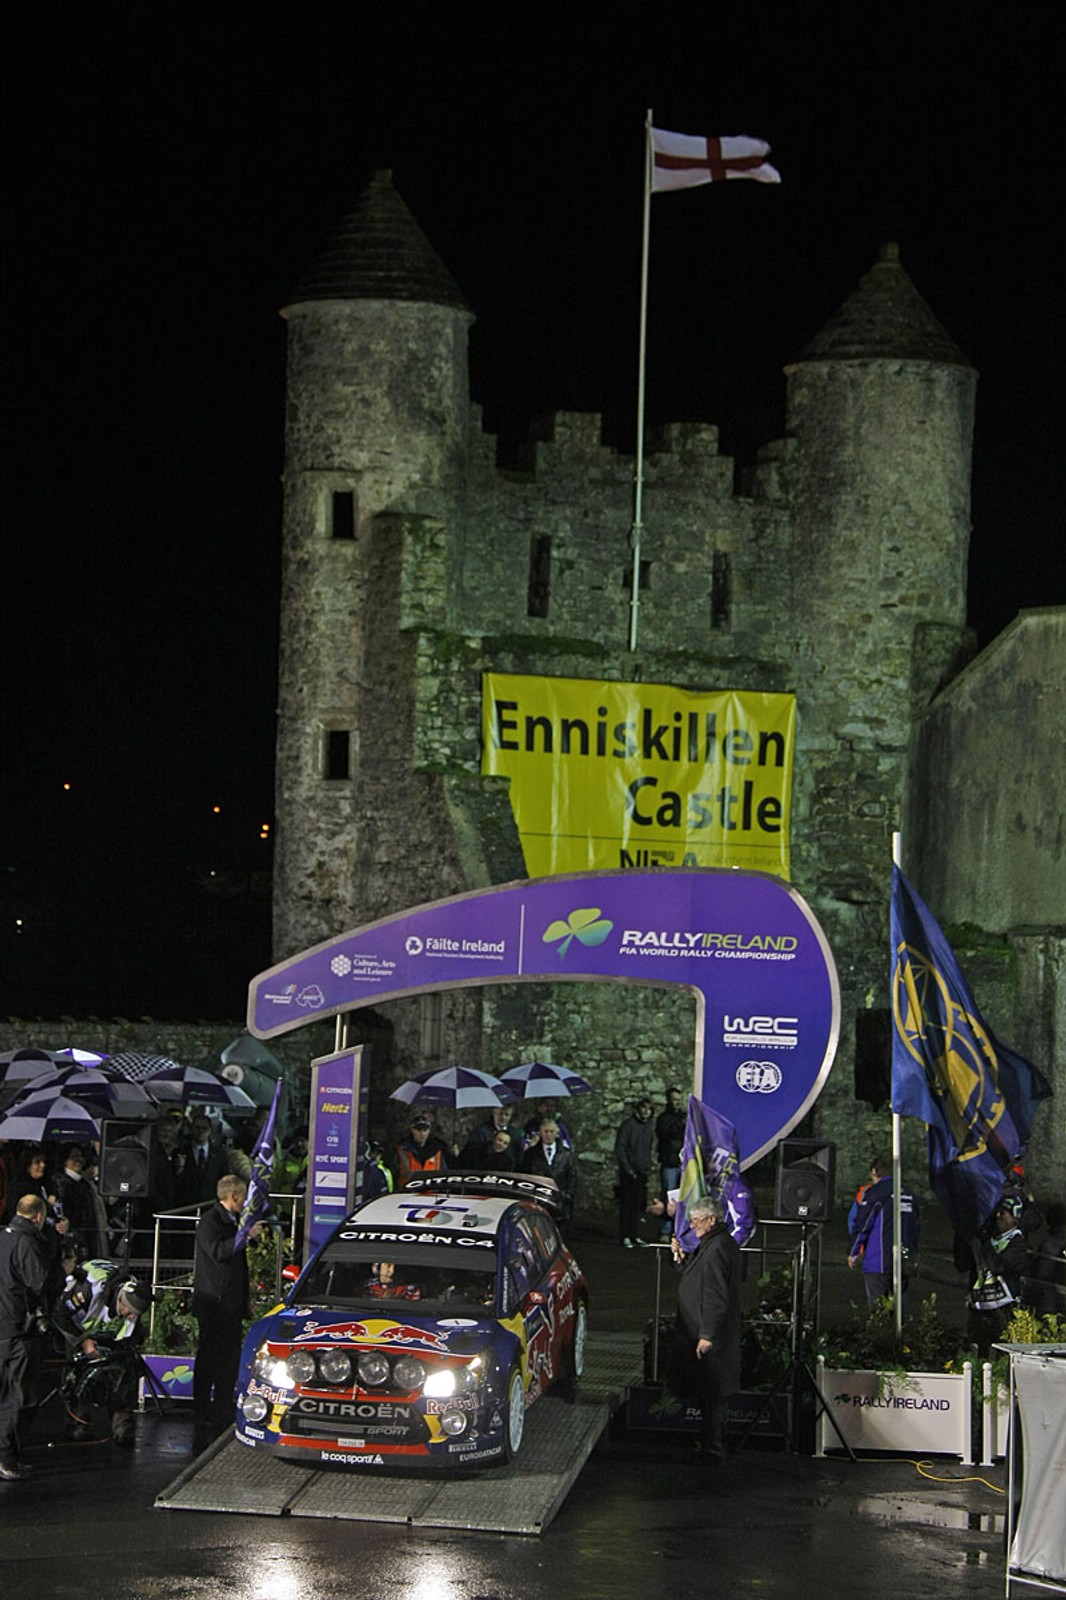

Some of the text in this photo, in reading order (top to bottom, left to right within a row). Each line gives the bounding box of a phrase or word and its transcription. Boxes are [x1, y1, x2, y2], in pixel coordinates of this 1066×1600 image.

[494, 700, 785, 767] Enniskillen
[627, 776, 782, 833] Castle
[462, 940, 505, 953] Ireland
[619, 947, 796, 961] FIA WORLD RALLY CHAMPIONSHIP
[724, 1015, 798, 1034] WRC
[321, 1102, 350, 1114] Hertz
[517, 1182, 553, 1196] C4
[339, 1231, 495, 1249] CITROËN C4
[299, 1399, 410, 1418] CITROËN
[366, 1425, 409, 1437] SPORT
[321, 1450, 373, 1465] le coq sportif
